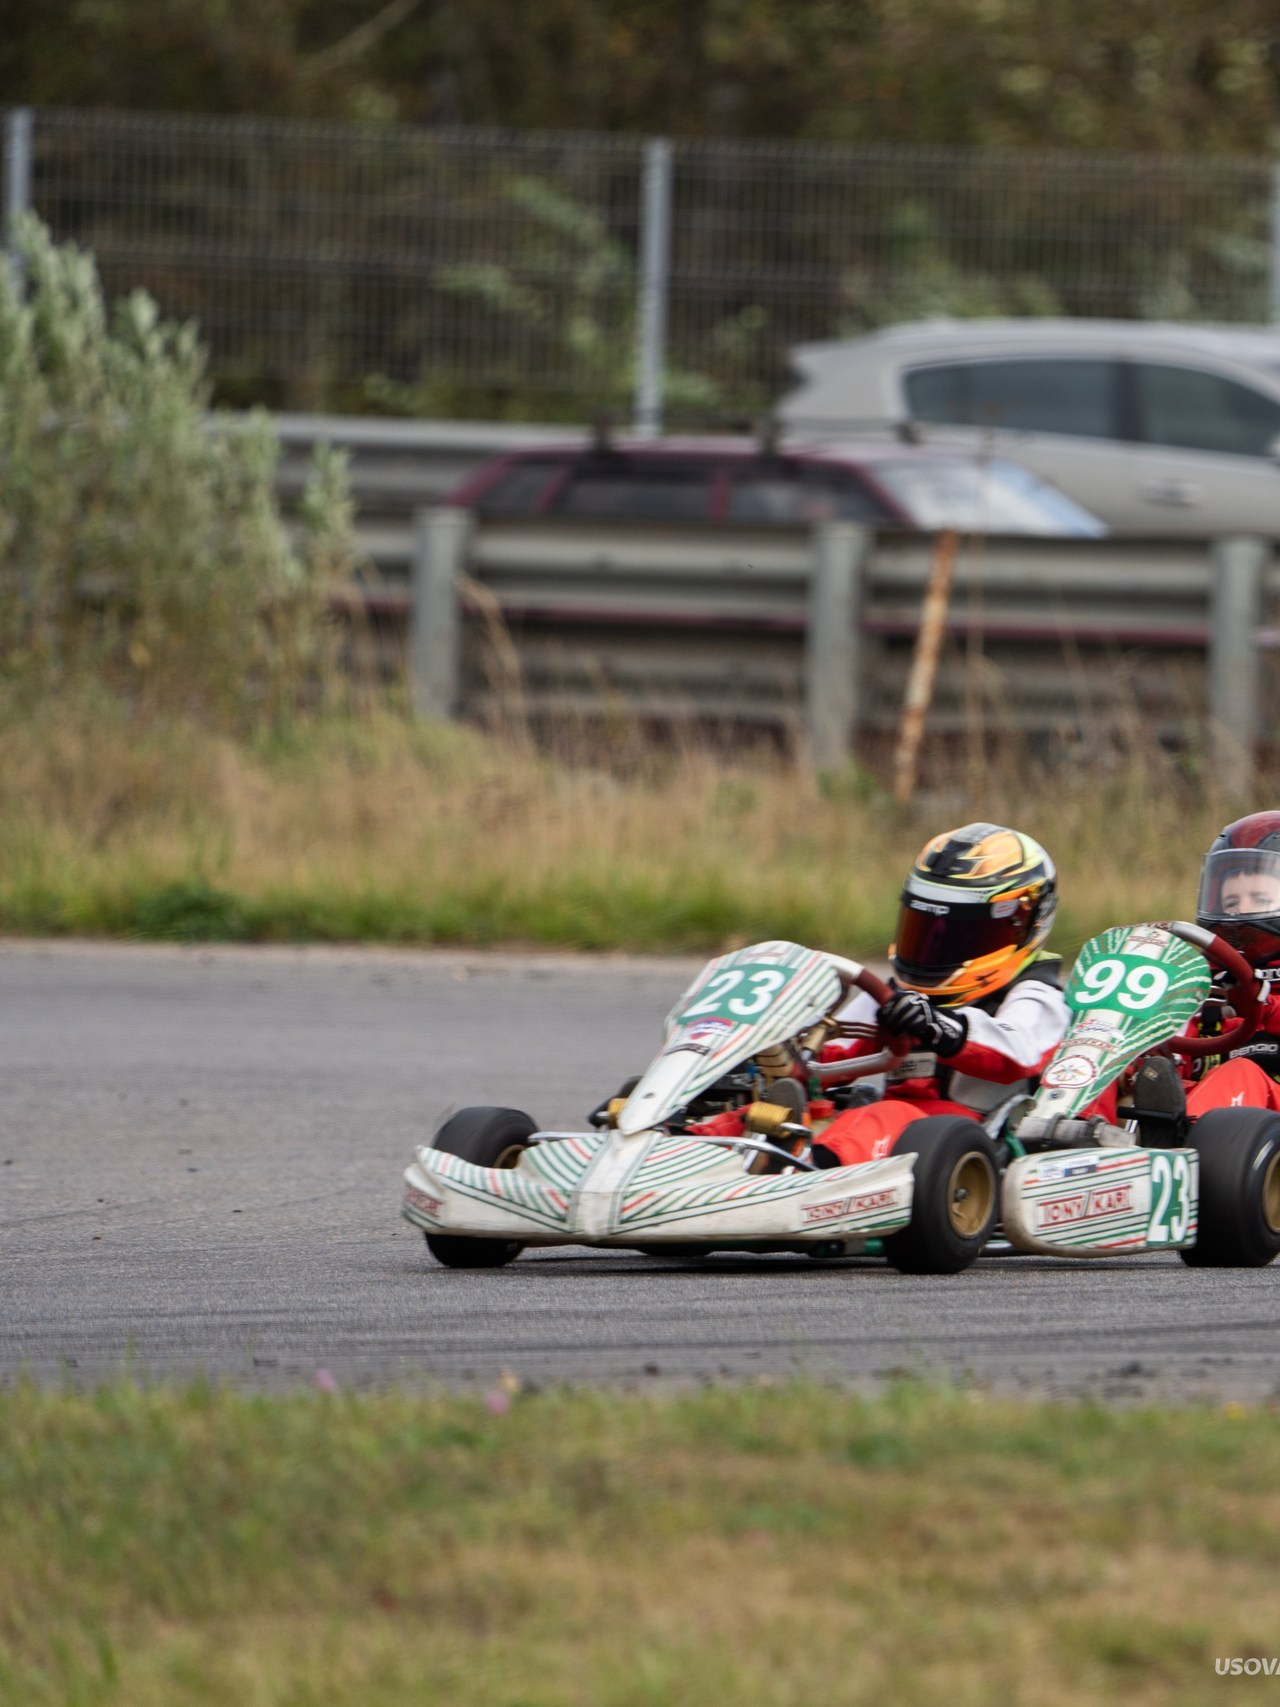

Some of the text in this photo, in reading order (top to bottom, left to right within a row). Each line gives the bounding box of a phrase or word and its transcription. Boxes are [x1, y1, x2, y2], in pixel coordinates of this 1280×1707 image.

[681, 970, 785, 1016] 23
[1075, 959, 1169, 1009] 99
[1147, 1155, 1190, 1242] 23
